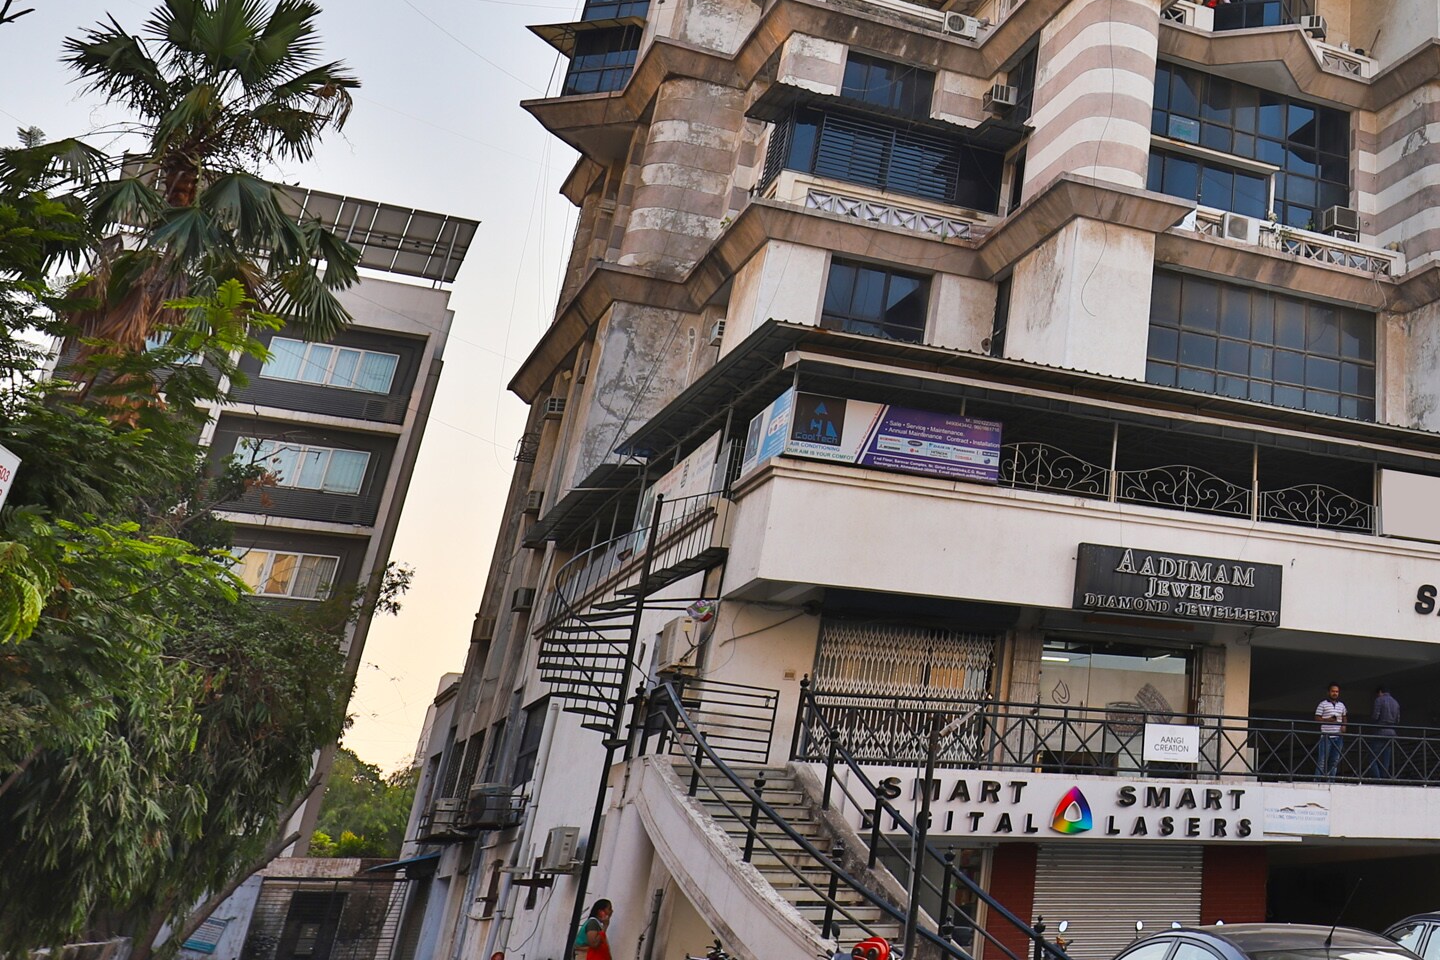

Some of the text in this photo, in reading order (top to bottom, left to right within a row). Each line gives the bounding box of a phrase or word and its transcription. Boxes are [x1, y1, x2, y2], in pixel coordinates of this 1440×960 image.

[800, 442, 840, 452] CONDITIONING
[888, 427, 908, 435] Annual
[908, 429, 943, 440] Maintenance
[946, 435, 969, 444] Contract
[972, 439, 1000, 448] Installation
[1115, 548, 1255, 587] AADIMAM
[1145, 577, 1224, 602] JEWELS
[1083, 592, 1279, 624] DIAMOND JEWELLERY
[1153, 743, 1189, 752] CREATION
[1160, 736, 1184, 744] AANGI
[881, 776, 1028, 804] SMART
[1117, 785, 1246, 811] SMART
[1105, 815, 1252, 837] LASERS
